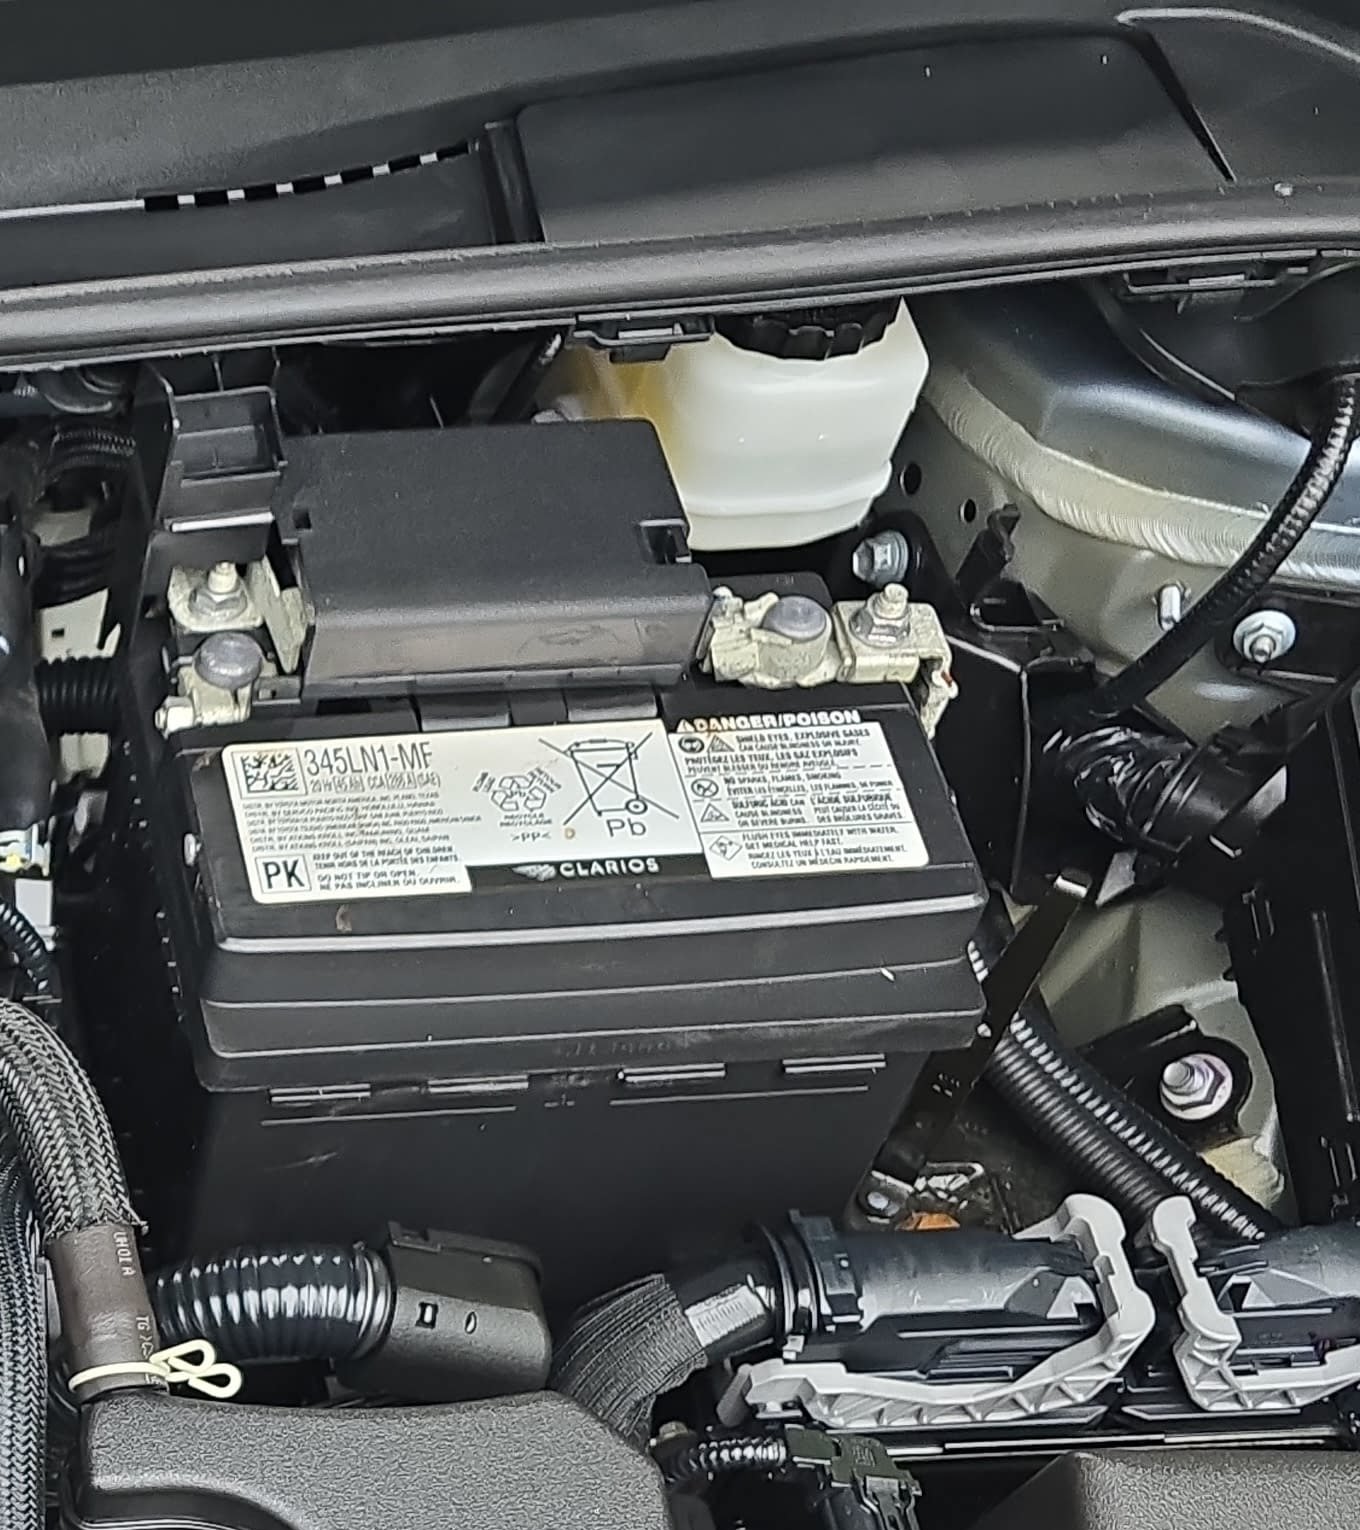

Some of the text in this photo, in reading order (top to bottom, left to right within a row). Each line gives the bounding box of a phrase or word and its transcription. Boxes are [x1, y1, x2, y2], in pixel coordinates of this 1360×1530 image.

[694, 710, 861, 732] DANGER/POISON
[304, 741, 432, 775] 345LN1-MF
[606, 817, 647, 837] Pb
[262, 859, 305, 889] PK
[559, 858, 659, 878] CLARIOS
